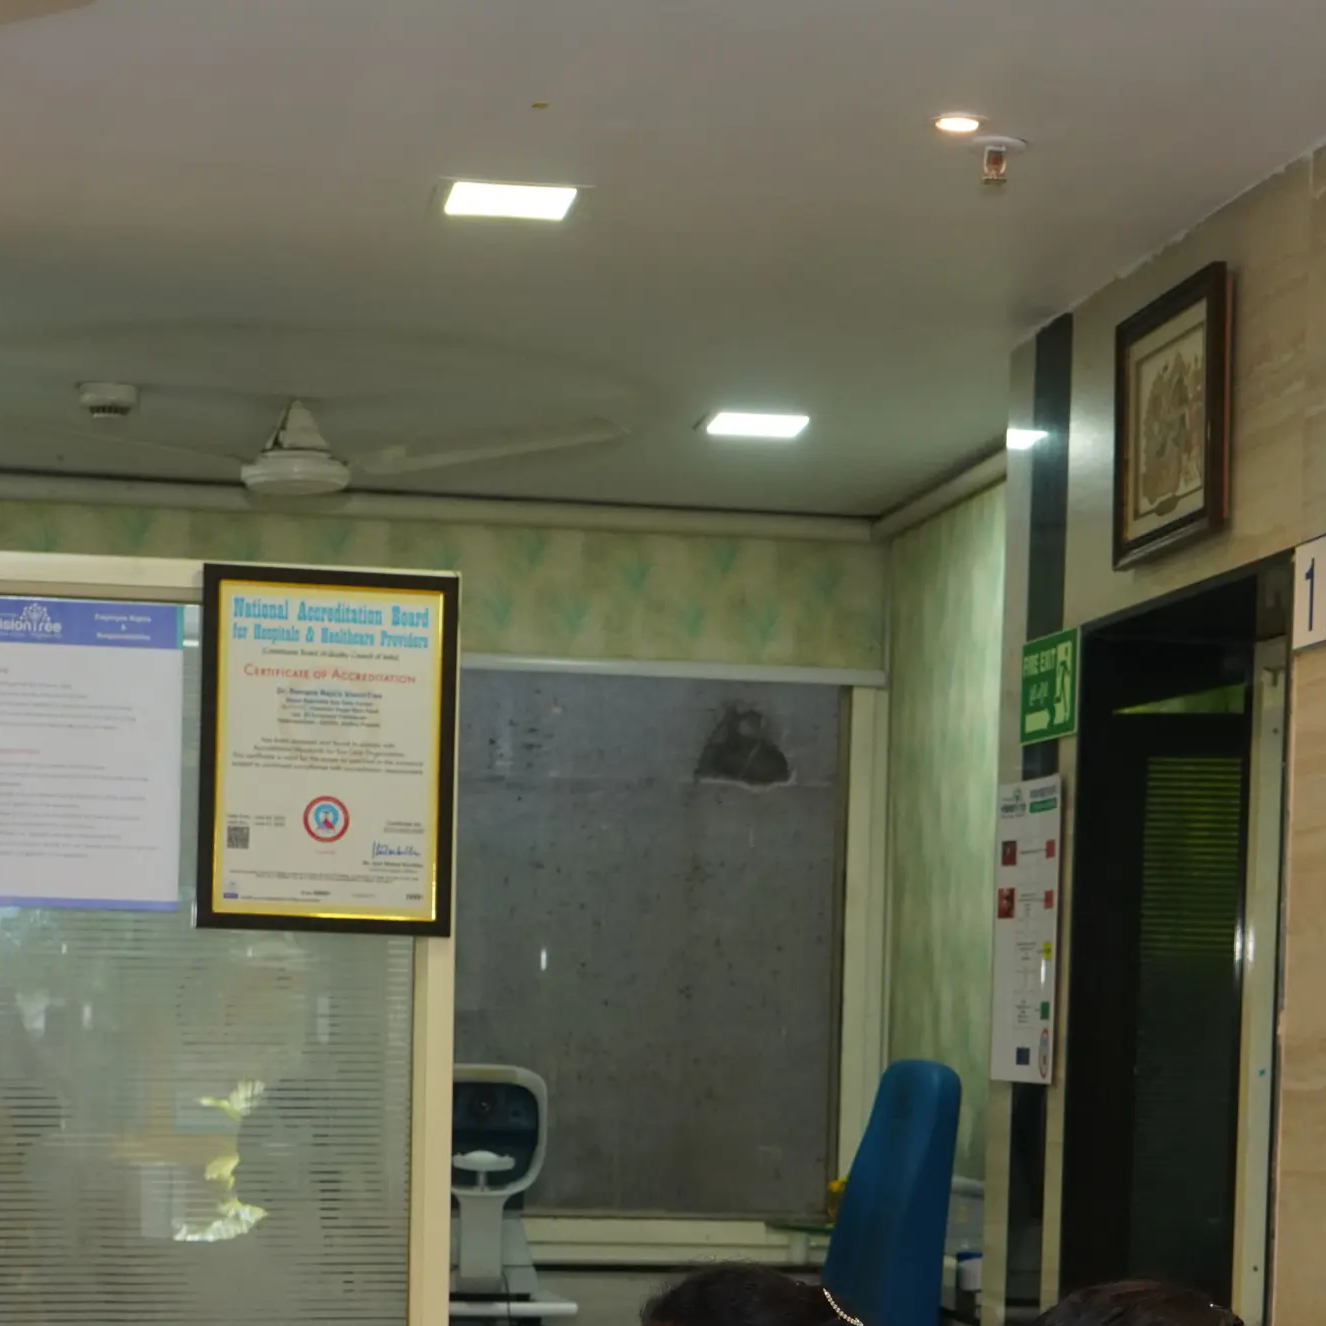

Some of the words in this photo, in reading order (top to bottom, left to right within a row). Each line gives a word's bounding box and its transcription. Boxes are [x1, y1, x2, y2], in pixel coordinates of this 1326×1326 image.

[1304, 557, 1315, 632] 1
[233, 597, 289, 621] National
[297, 600, 383, 626] Accreditation
[391, 605, 429, 628] Board
[233, 622, 248, 639] for
[253, 623, 300, 645] Hospitals
[305, 625, 316, 643] &
[321, 627, 375, 647] Healthcare
[380, 630, 429, 649] Providers
[1040, 647, 1057, 673] EXIT
